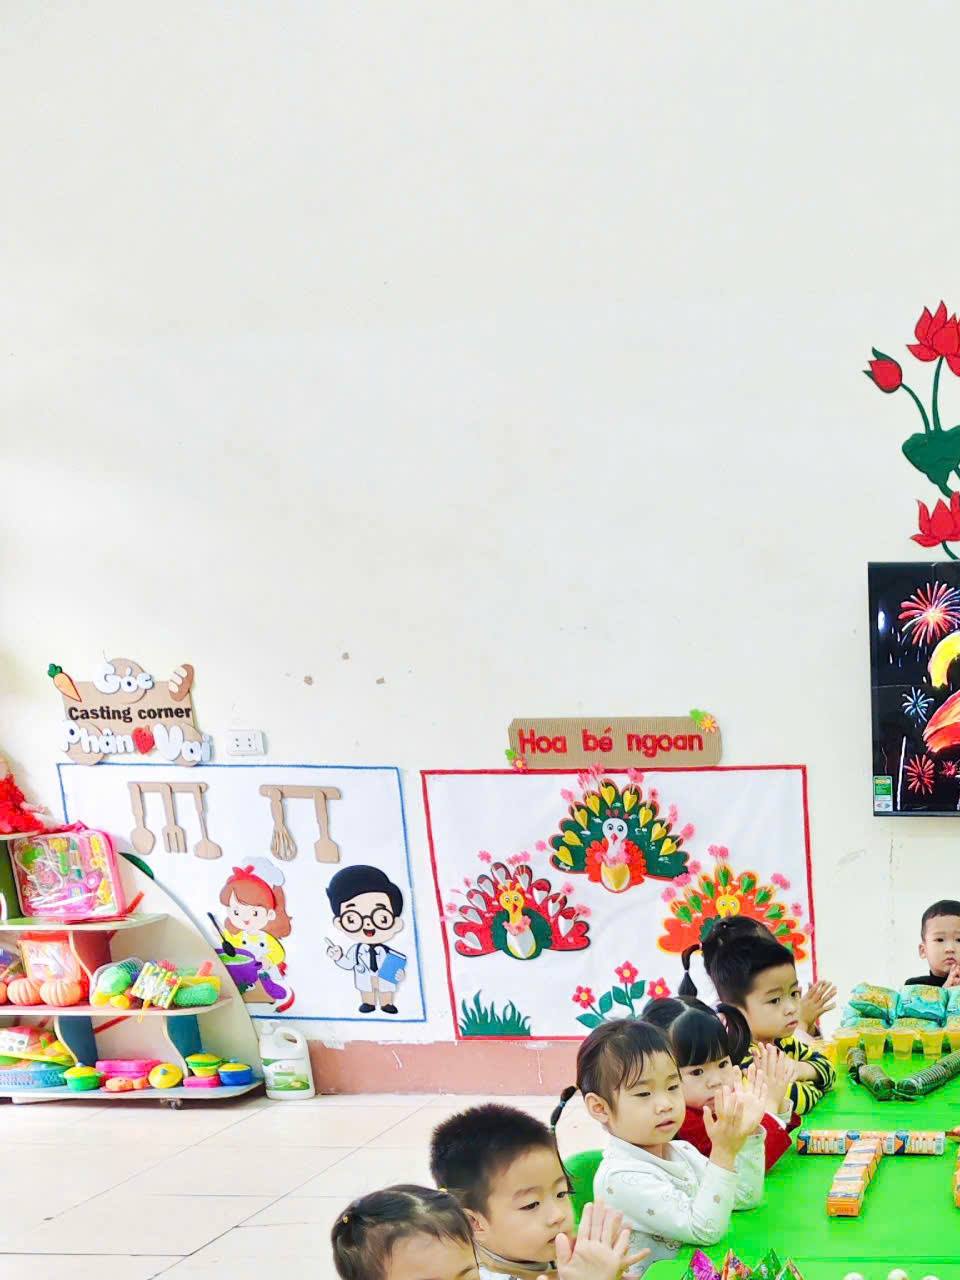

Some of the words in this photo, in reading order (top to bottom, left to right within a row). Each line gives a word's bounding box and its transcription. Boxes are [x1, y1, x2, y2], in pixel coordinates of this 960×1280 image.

[68, 706, 132, 723] Casting
[138, 706, 192, 720] corner
[518, 728, 568, 754] Hoa
[582, 726, 614, 752] bé
[627, 733, 704, 758] ngoan
